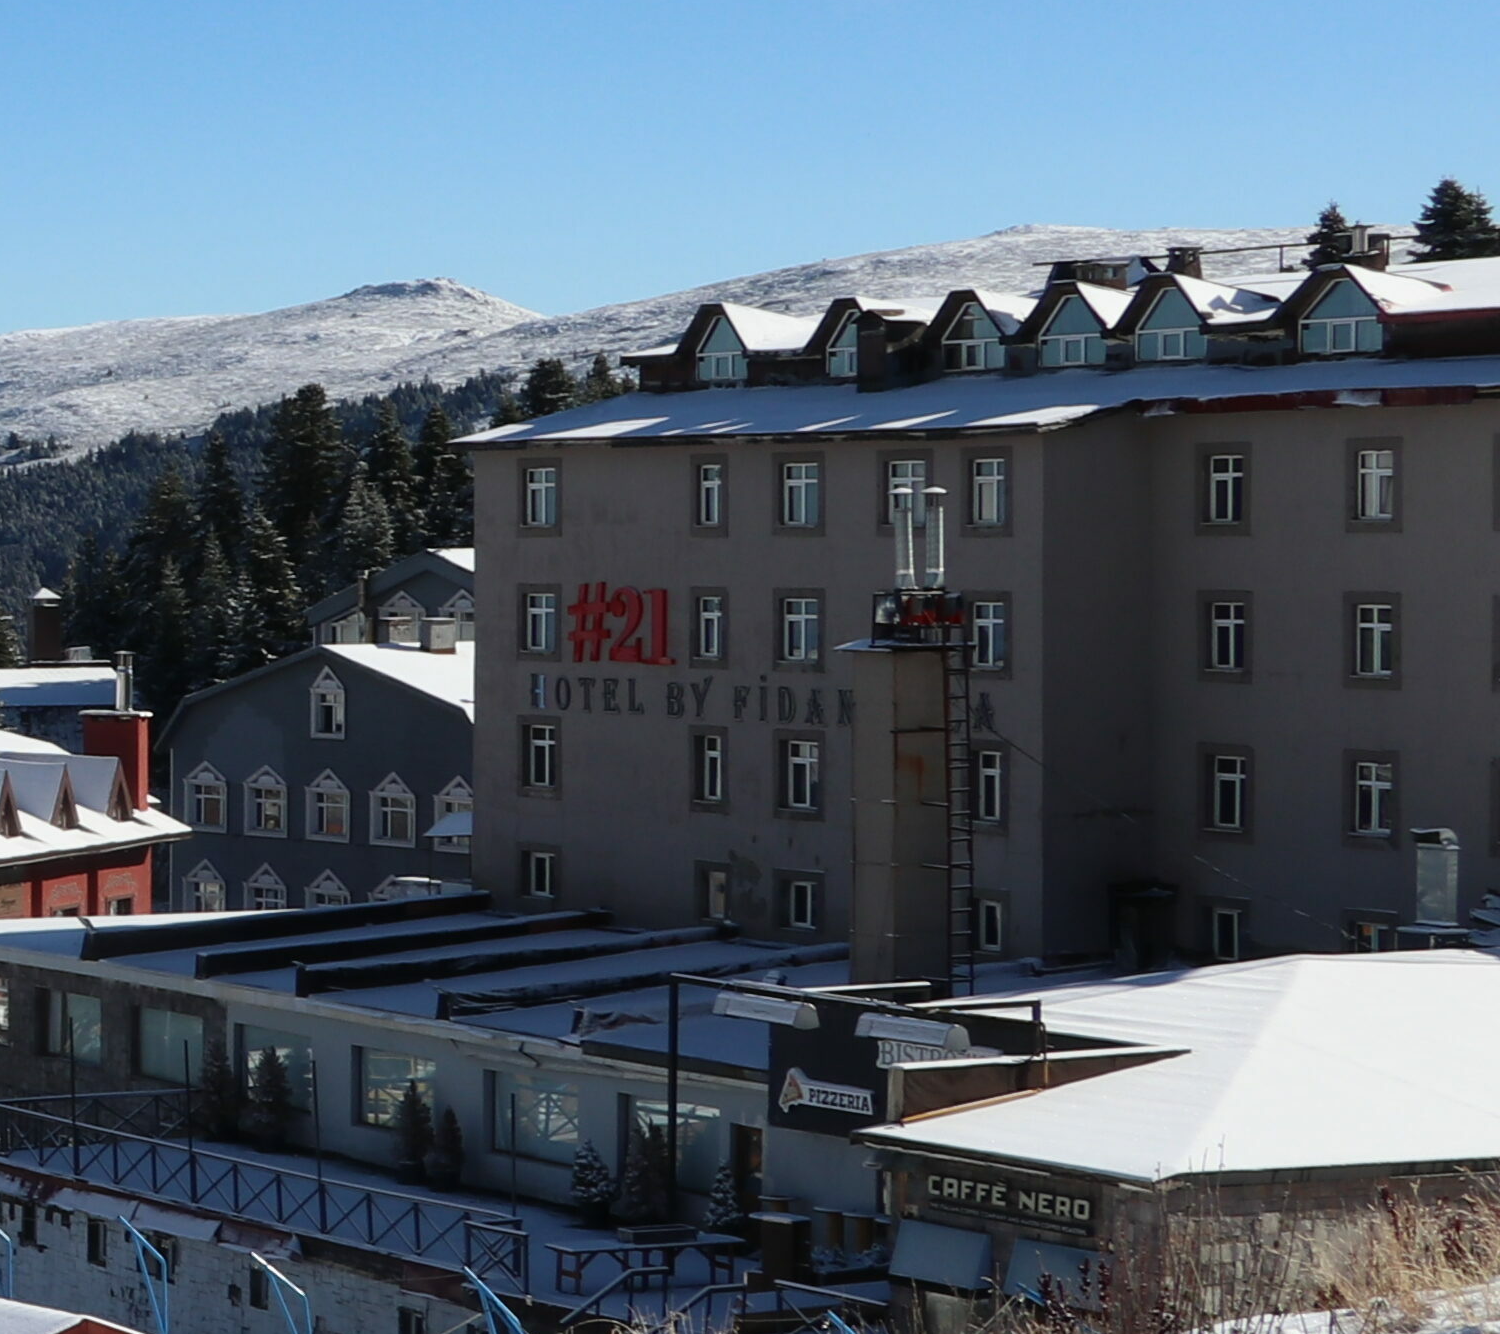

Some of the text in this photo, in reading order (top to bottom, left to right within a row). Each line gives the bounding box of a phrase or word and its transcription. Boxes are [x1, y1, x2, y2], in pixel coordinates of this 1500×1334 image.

[567, 582, 677, 665] #21
[531, 673, 645, 715] HOTEL
[666, 675, 714, 718] BY
[808, 1087, 870, 1112] PIZZERIA
[1018, 1190, 1090, 1221] NERO
